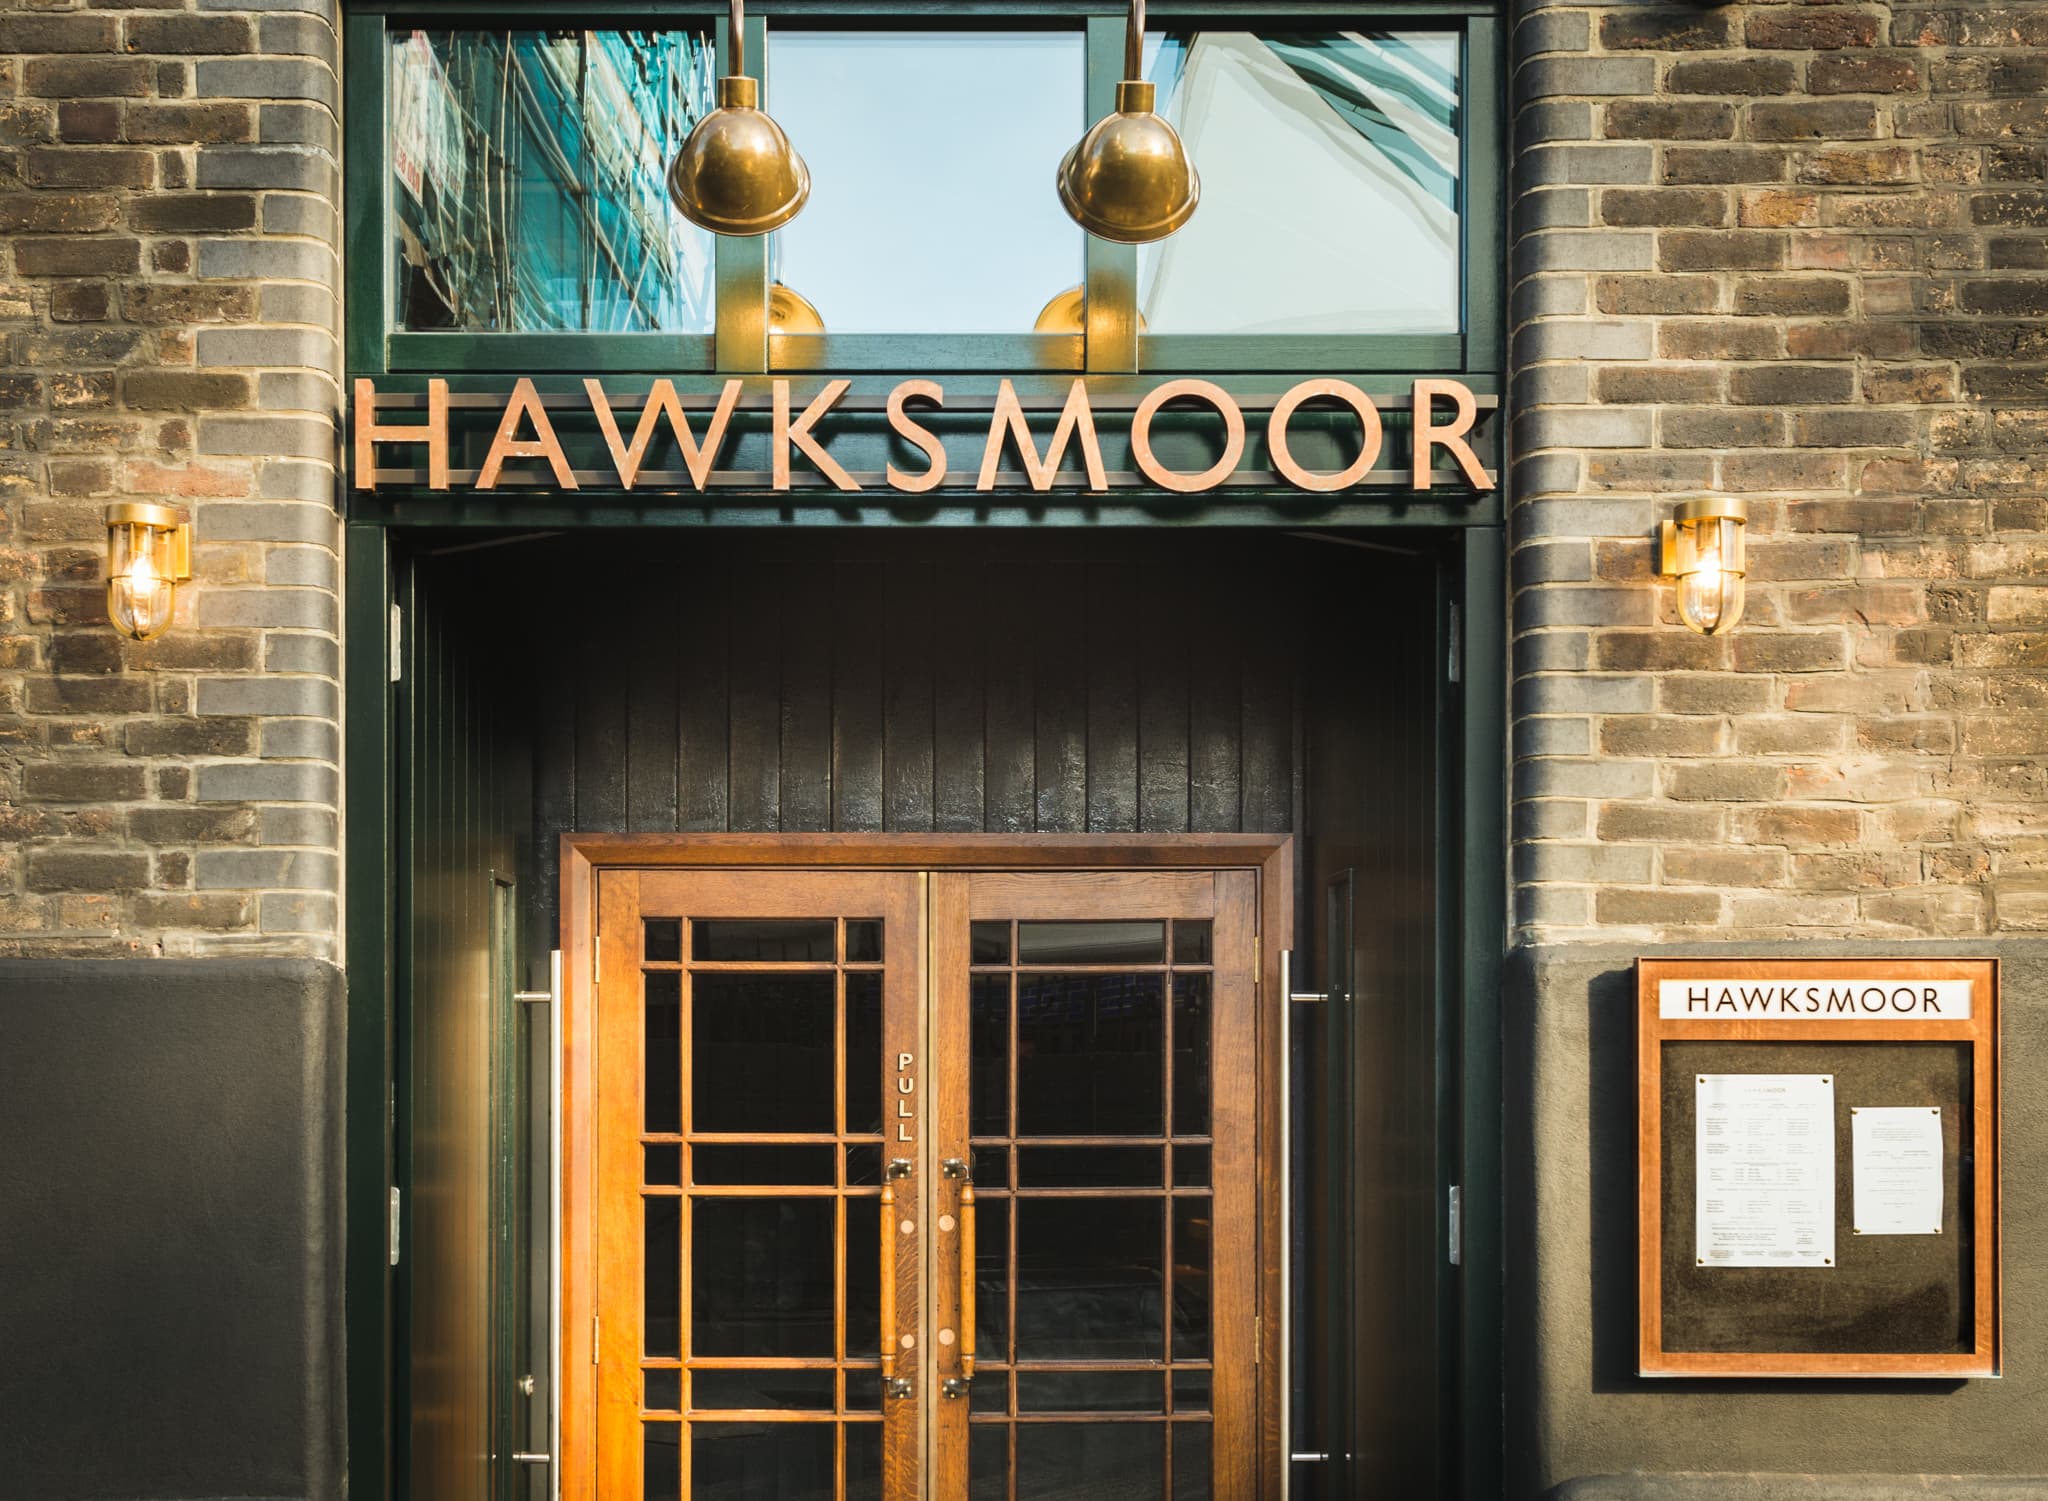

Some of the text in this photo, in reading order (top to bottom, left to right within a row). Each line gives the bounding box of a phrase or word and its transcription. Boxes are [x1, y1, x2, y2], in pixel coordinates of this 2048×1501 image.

[354, 378, 1496, 492] HAWKSMOOR
[1688, 987, 1942, 1013] HAWKSMOOR
[898, 1053, 914, 1142] PULL
